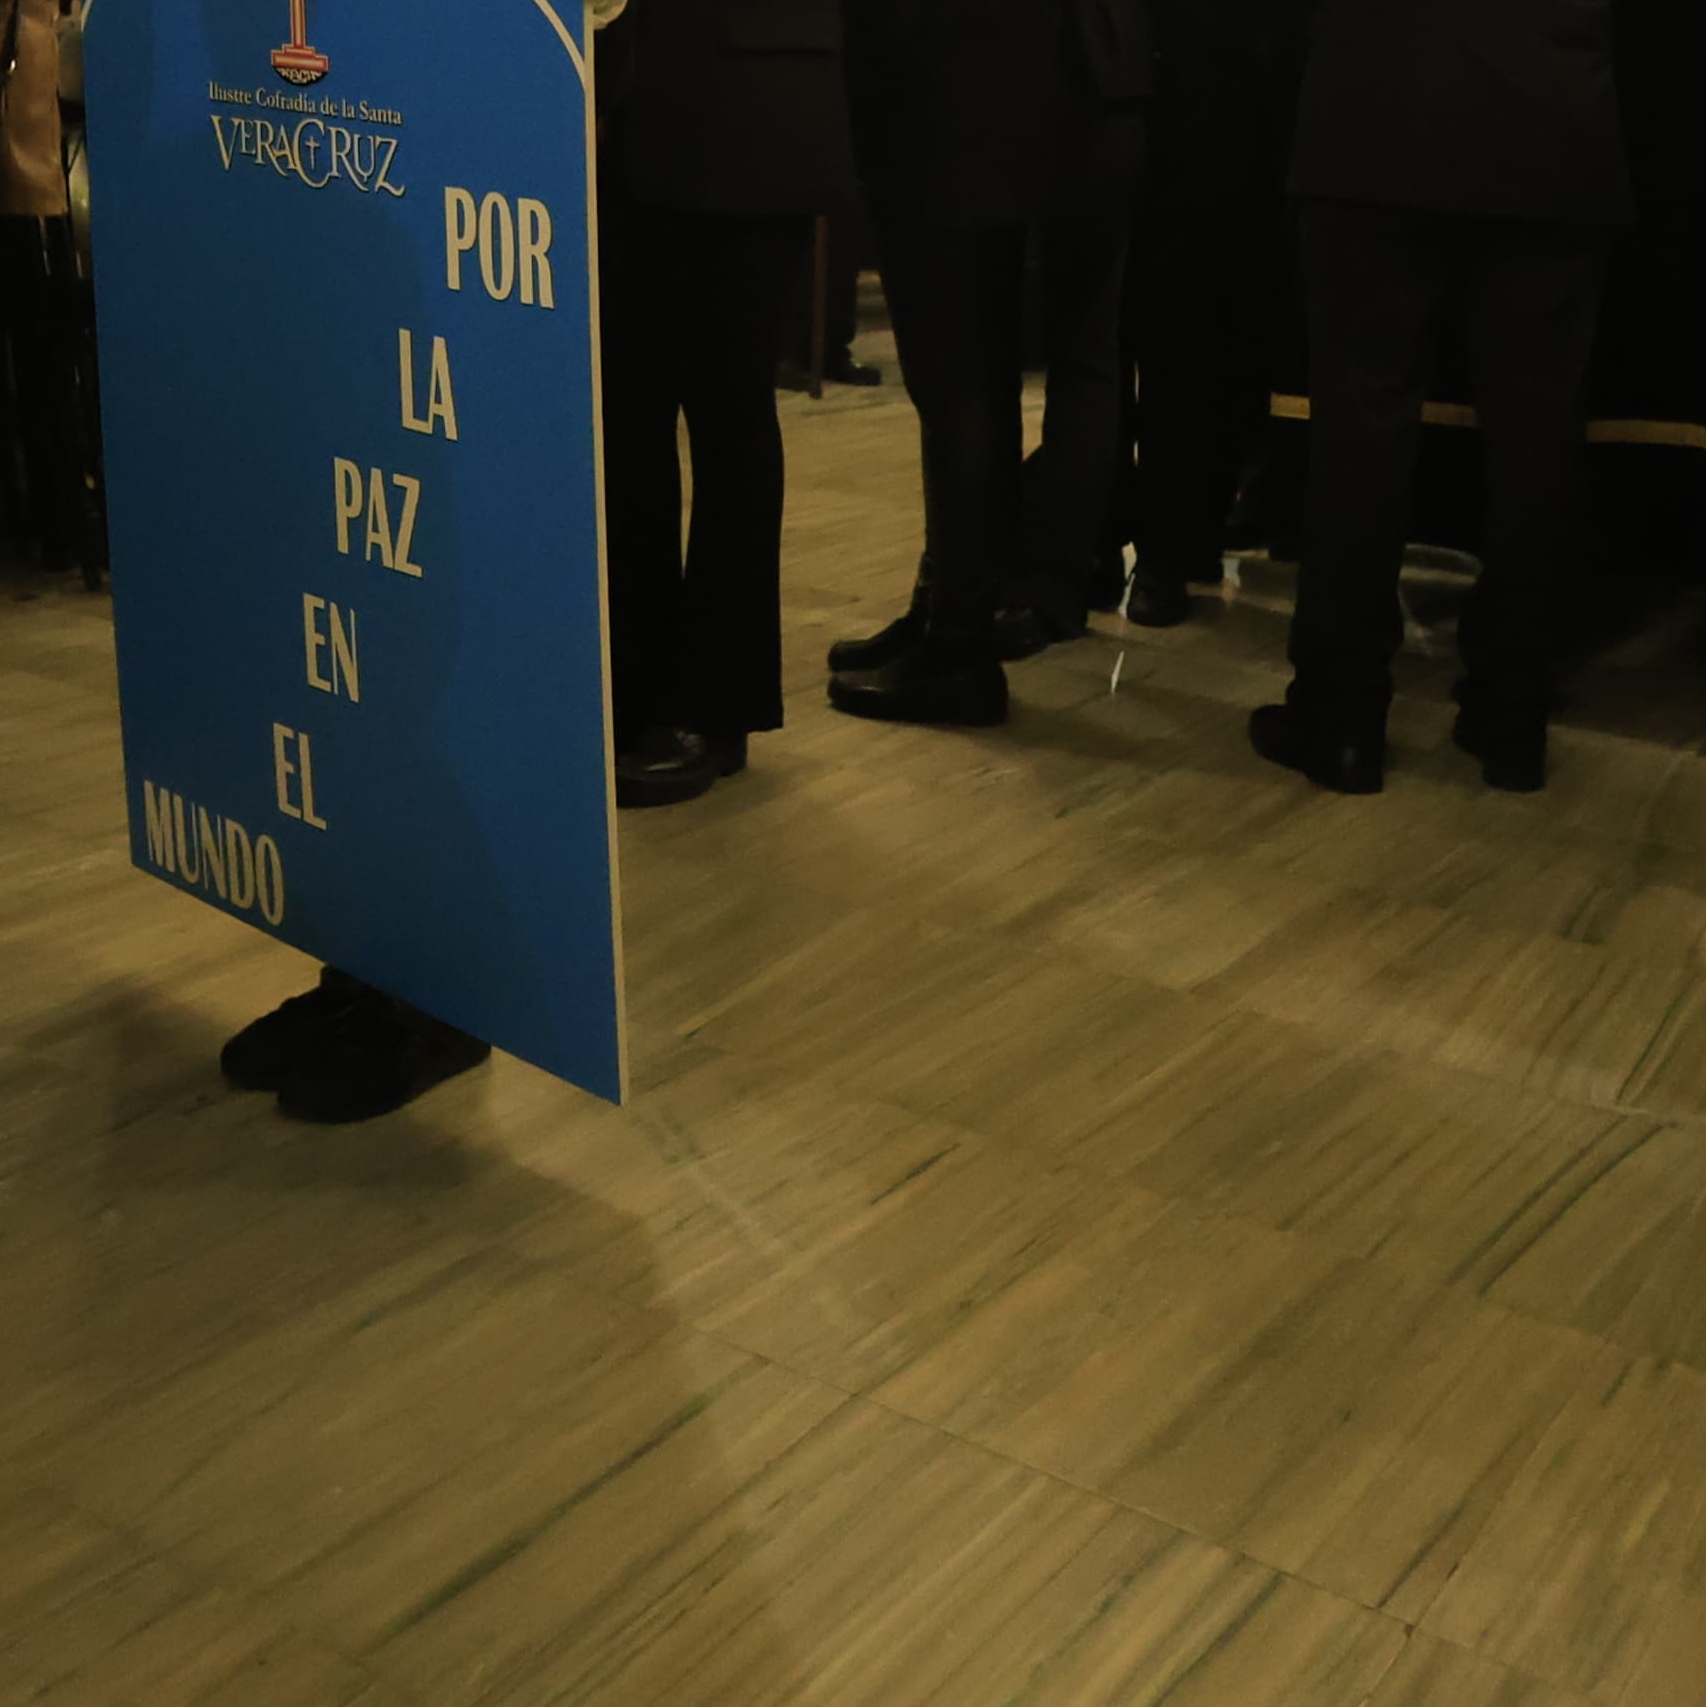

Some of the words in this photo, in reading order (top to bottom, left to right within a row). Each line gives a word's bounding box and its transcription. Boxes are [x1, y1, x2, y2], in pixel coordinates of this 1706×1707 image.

[209, 80, 252, 105] Ilustre
[256, 87, 317, 115] Cofradía
[321, 96, 339, 116] de
[342, 99, 356, 119] la
[359, 100, 403, 125] Santa
[444, 186, 555, 310] POR
[398, 328, 459, 442] LA
[333, 456, 424, 578] PAZ
[302, 592, 361, 703] EN
[272, 721, 328, 831] EL
[142, 779, 285, 926] MUNDO
